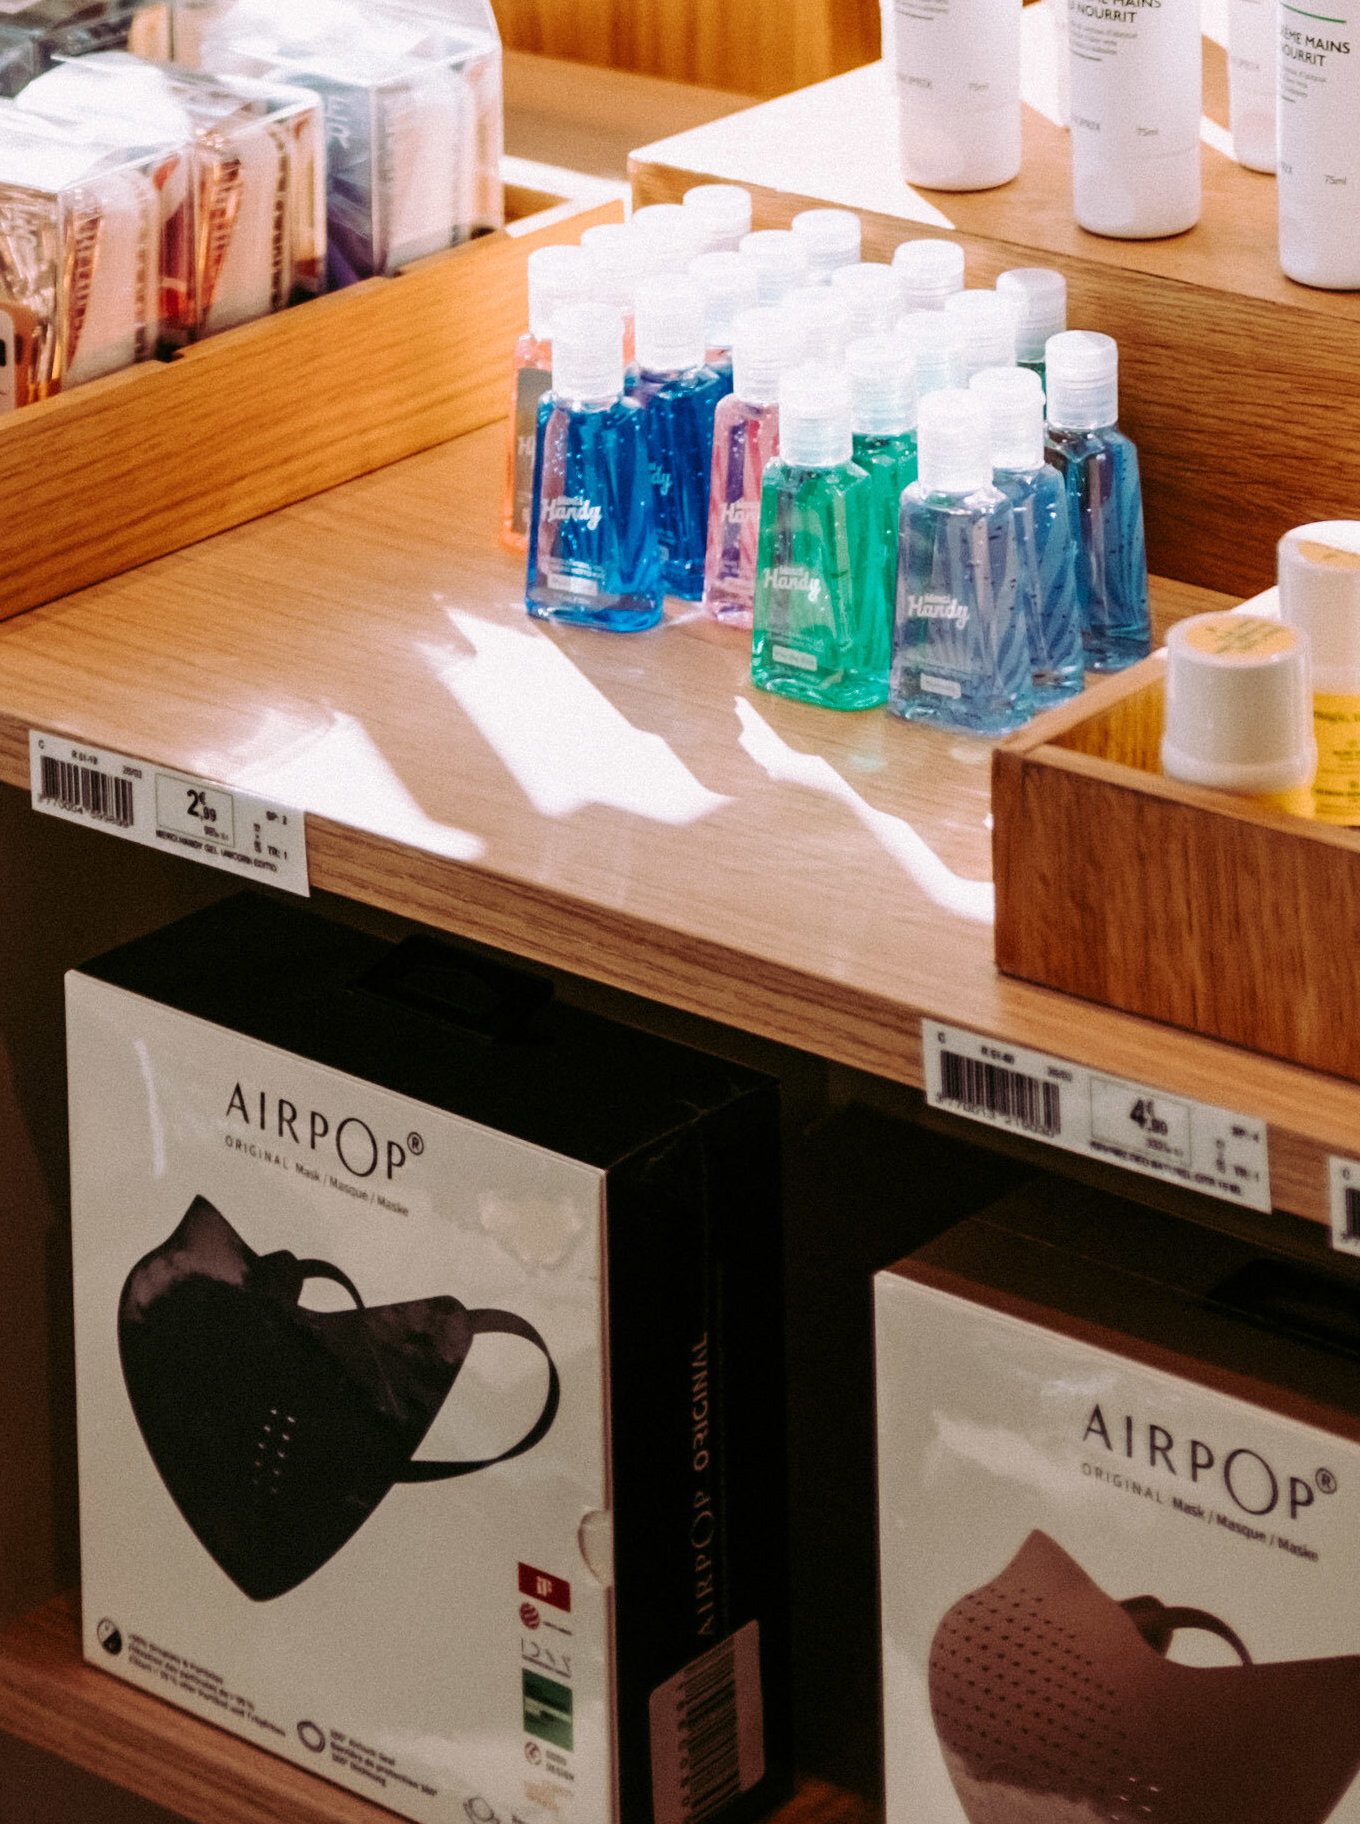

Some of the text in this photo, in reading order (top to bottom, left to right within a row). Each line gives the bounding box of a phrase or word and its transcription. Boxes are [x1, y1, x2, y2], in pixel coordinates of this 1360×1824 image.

[1078, 3, 1137, 24] NOURRIT
[1305, 35, 1350, 54] MAINS
[1324, 174, 1347, 186] 75ml
[541, 498, 602, 530] Handy
[763, 567, 821, 602] Handy
[907, 595, 969, 629] Handy
[225, 1135, 288, 1170] ORIGINAL
[296, 1163, 320, 1181] Mask
[330, 1175, 368, 1202] Masque
[377, 1196, 409, 1216] Maske
[1082, 1463, 1163, 1503] ORIGINAL
[1172, 1496, 1205, 1518] Mask
[1217, 1514, 1266, 1542] Masque
[1278, 1537, 1319, 1563] Maske
